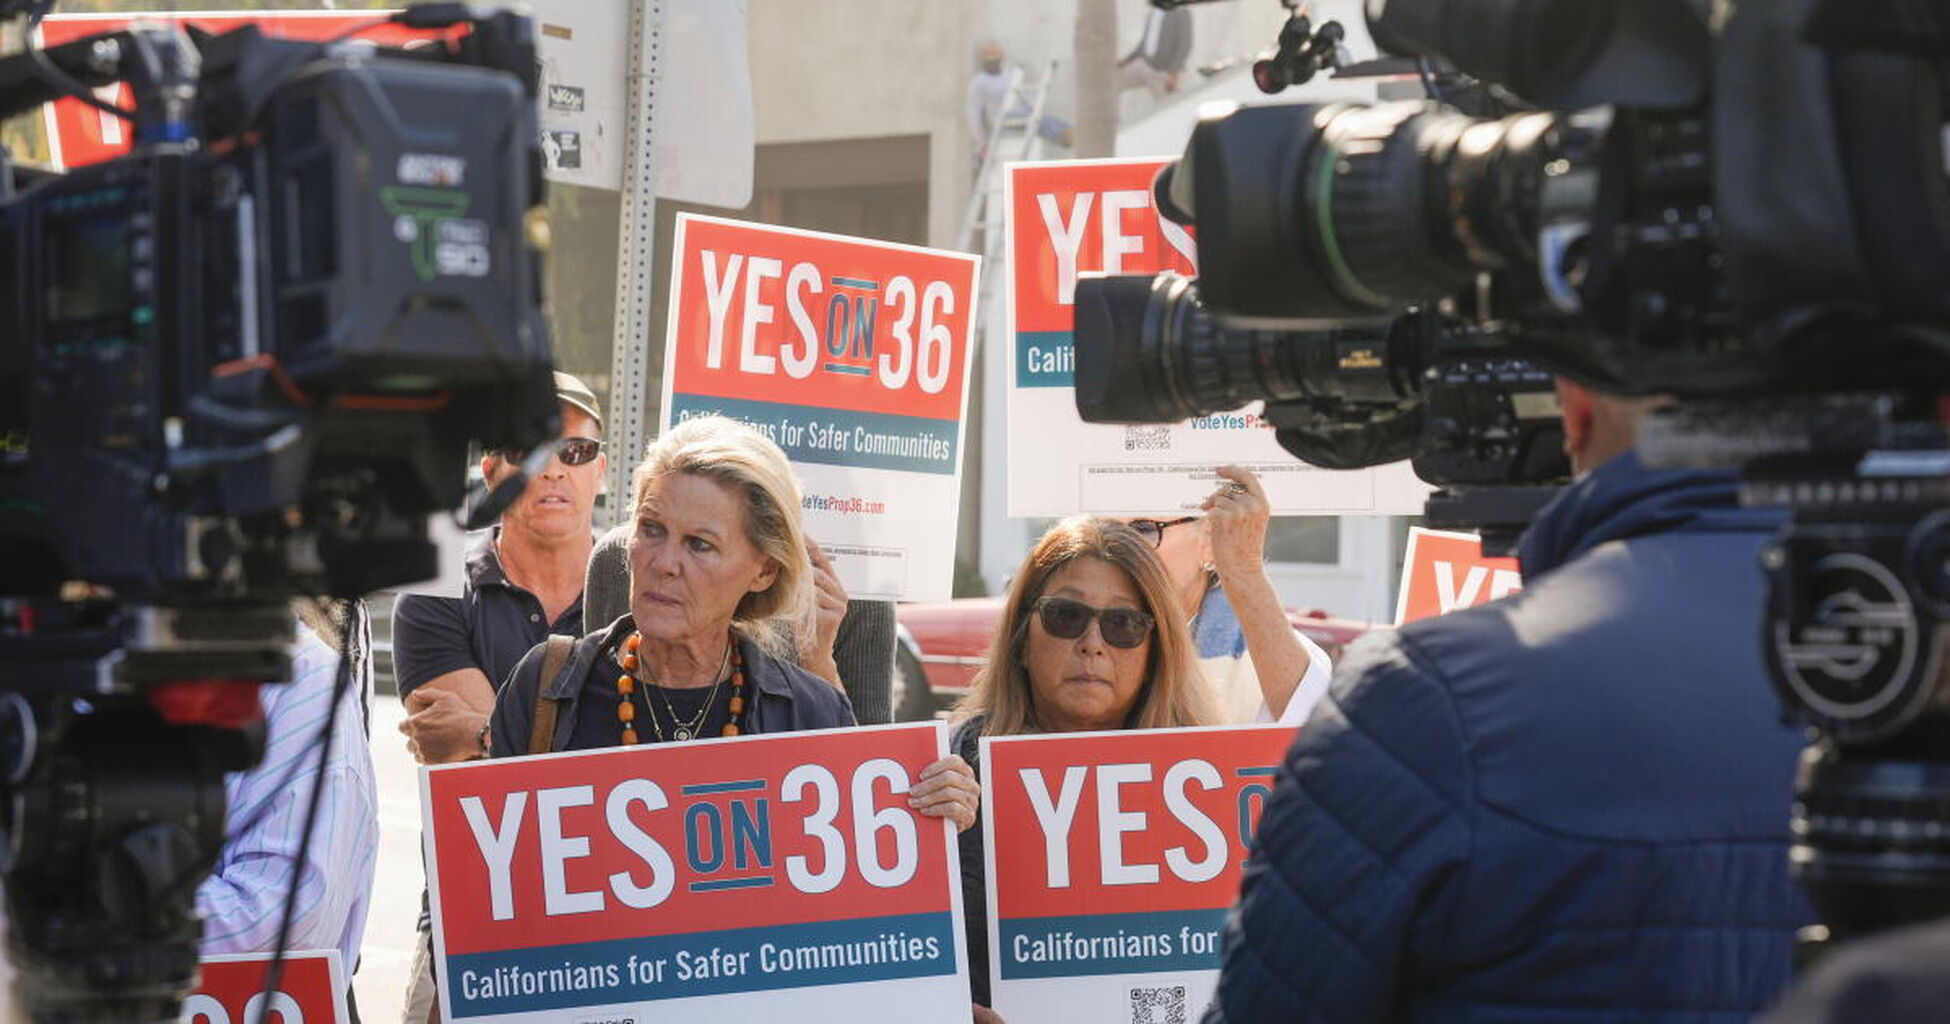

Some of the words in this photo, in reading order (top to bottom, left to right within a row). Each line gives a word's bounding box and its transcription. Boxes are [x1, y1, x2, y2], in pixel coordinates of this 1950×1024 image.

[701, 249, 824, 380] YES
[825, 293, 877, 361] ON
[878, 275, 956, 394] 36
[781, 419, 802, 448] for
[808, 421, 850, 452] Safer
[854, 426, 950, 460] Communities
[459, 778, 676, 921] YES
[684, 797, 773, 874] ON
[780, 758, 919, 893] 36
[1018, 758, 1228, 888] YES
[1238, 784, 1273, 850] O
[462, 959, 620, 1001] Californians
[627, 952, 667, 985] for
[676, 949, 751, 981] Safer
[759, 932, 940, 974] Communities
[1013, 930, 1172, 962] Californians
[1180, 926, 1218, 955] for
